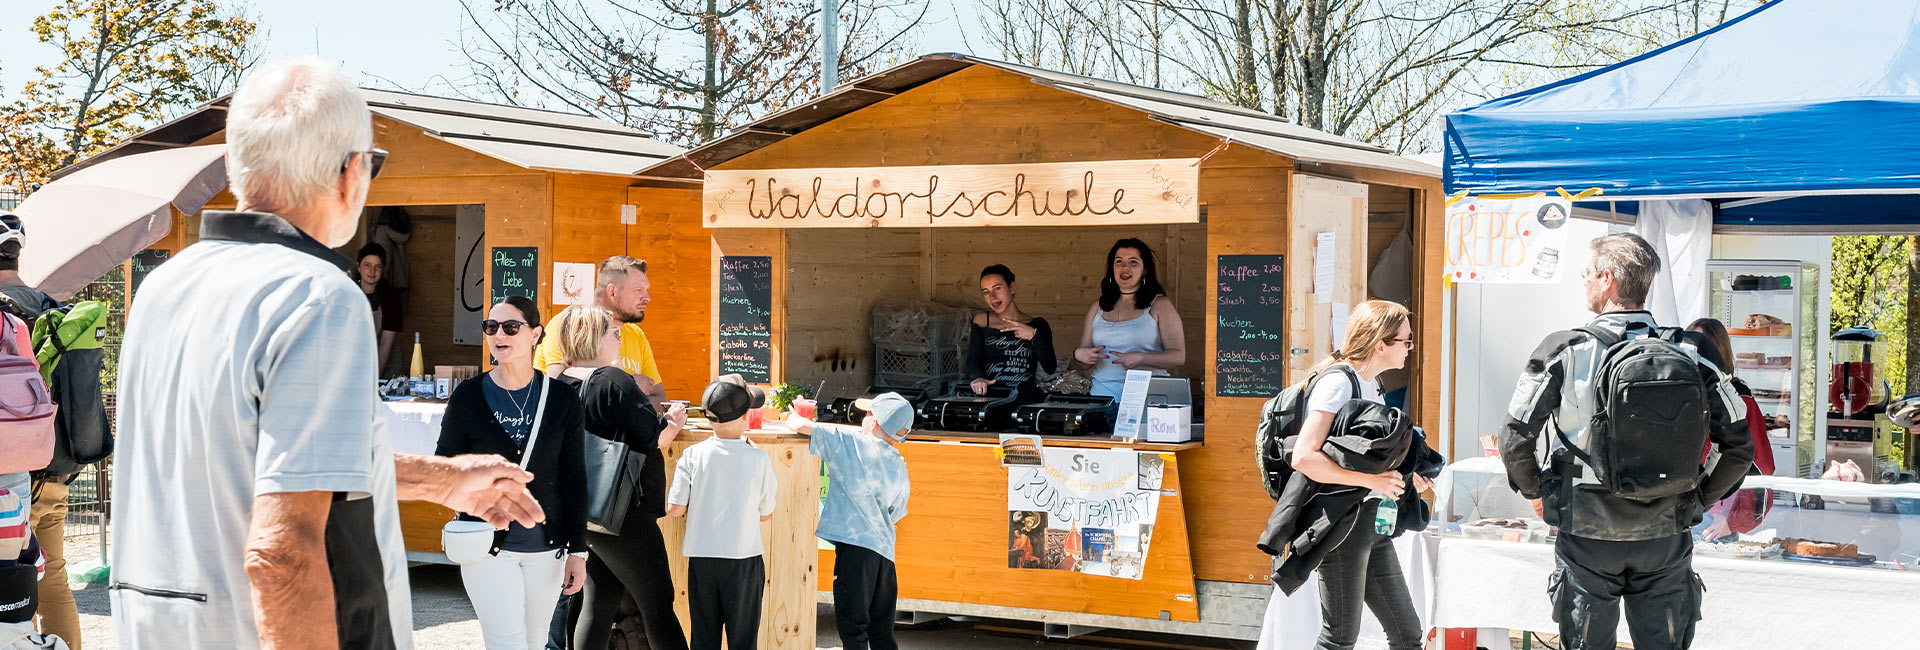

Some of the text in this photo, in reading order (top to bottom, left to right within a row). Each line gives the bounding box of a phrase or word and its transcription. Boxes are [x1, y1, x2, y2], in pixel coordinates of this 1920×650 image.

[746, 170, 1135, 224] Waldorfschule
[1446, 210, 1533, 268] CREPES
[494, 250, 535, 268] Alles mit
[722, 260, 750, 273] Kaffee
[1220, 264, 1282, 282] Kaffee 2,50
[502, 270, 524, 288] Liebe
[722, 271, 769, 280] Tee 2,00
[722, 282, 744, 292] Slush
[1218, 282, 1281, 293] Tee 2,00
[1218, 295, 1280, 306] Slush 3,50
[1219, 315, 1255, 328] Kuchen
[719, 339, 748, 351] Ciabatta
[1217, 349, 1256, 360] Ciabatta
[1260, 351, 1280, 361] 6,50
[1216, 363, 1254, 374] Ciabatta
[1071, 453, 1100, 475] Sie
[1013, 467, 1151, 528] KUNSTFAHRT
